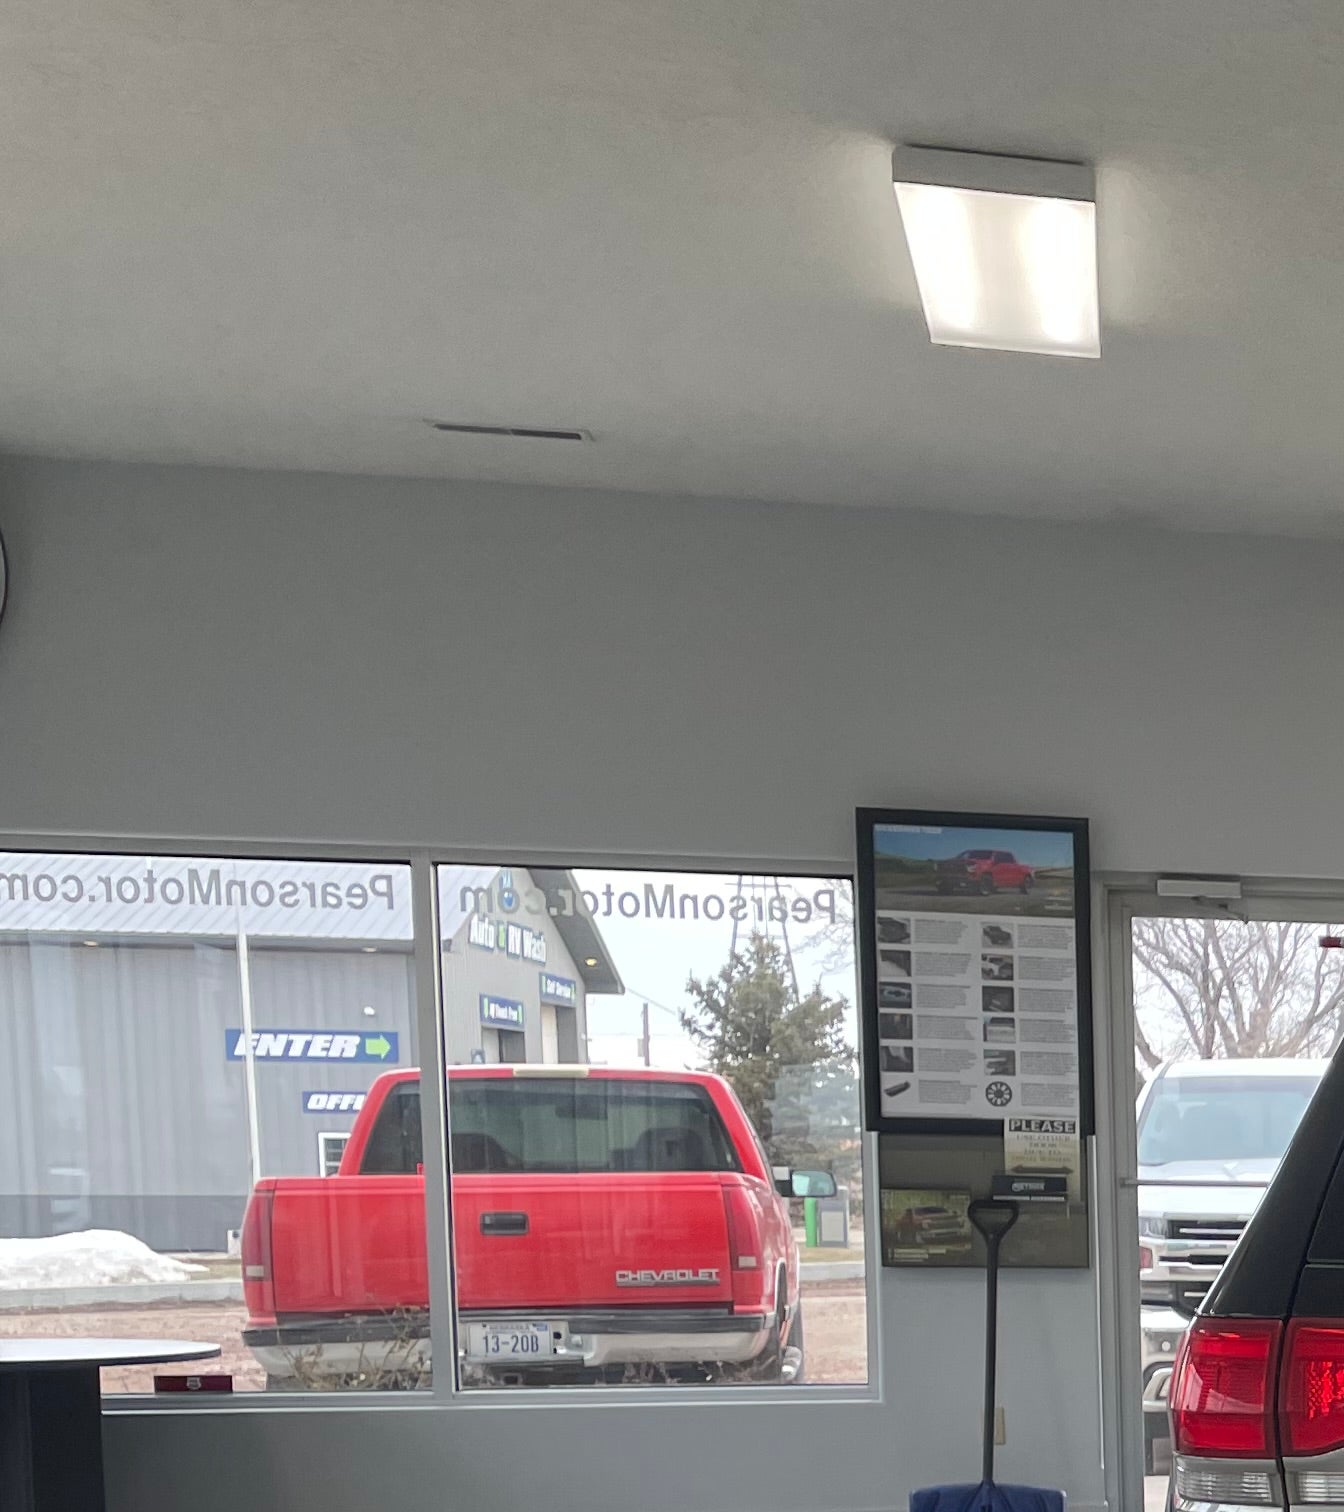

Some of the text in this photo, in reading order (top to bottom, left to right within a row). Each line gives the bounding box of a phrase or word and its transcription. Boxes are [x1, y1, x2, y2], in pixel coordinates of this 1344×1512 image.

[234, 1033, 361, 1058] ENTER
[1010, 1119, 1075, 1133] PLEASE
[616, 1268, 720, 1284] CHEVROLET
